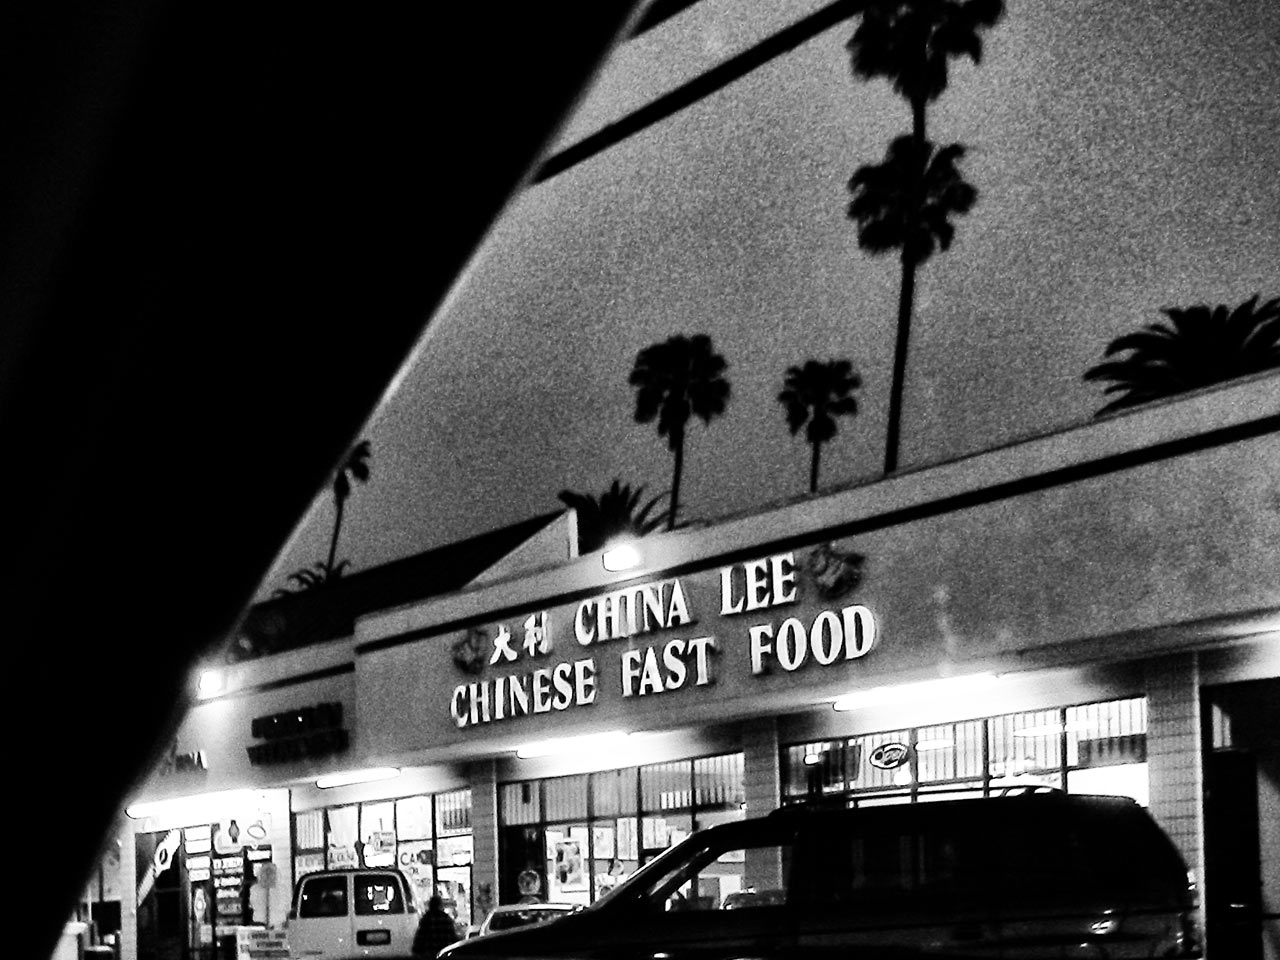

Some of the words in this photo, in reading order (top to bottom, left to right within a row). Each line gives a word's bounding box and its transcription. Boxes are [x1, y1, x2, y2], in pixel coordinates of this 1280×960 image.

[574, 578, 691, 646] CHINA
[720, 552, 797, 616] LEE
[450, 659, 596, 728] CHINESE
[621, 636, 715, 698] FAST
[749, 604, 877, 675] FOOD
